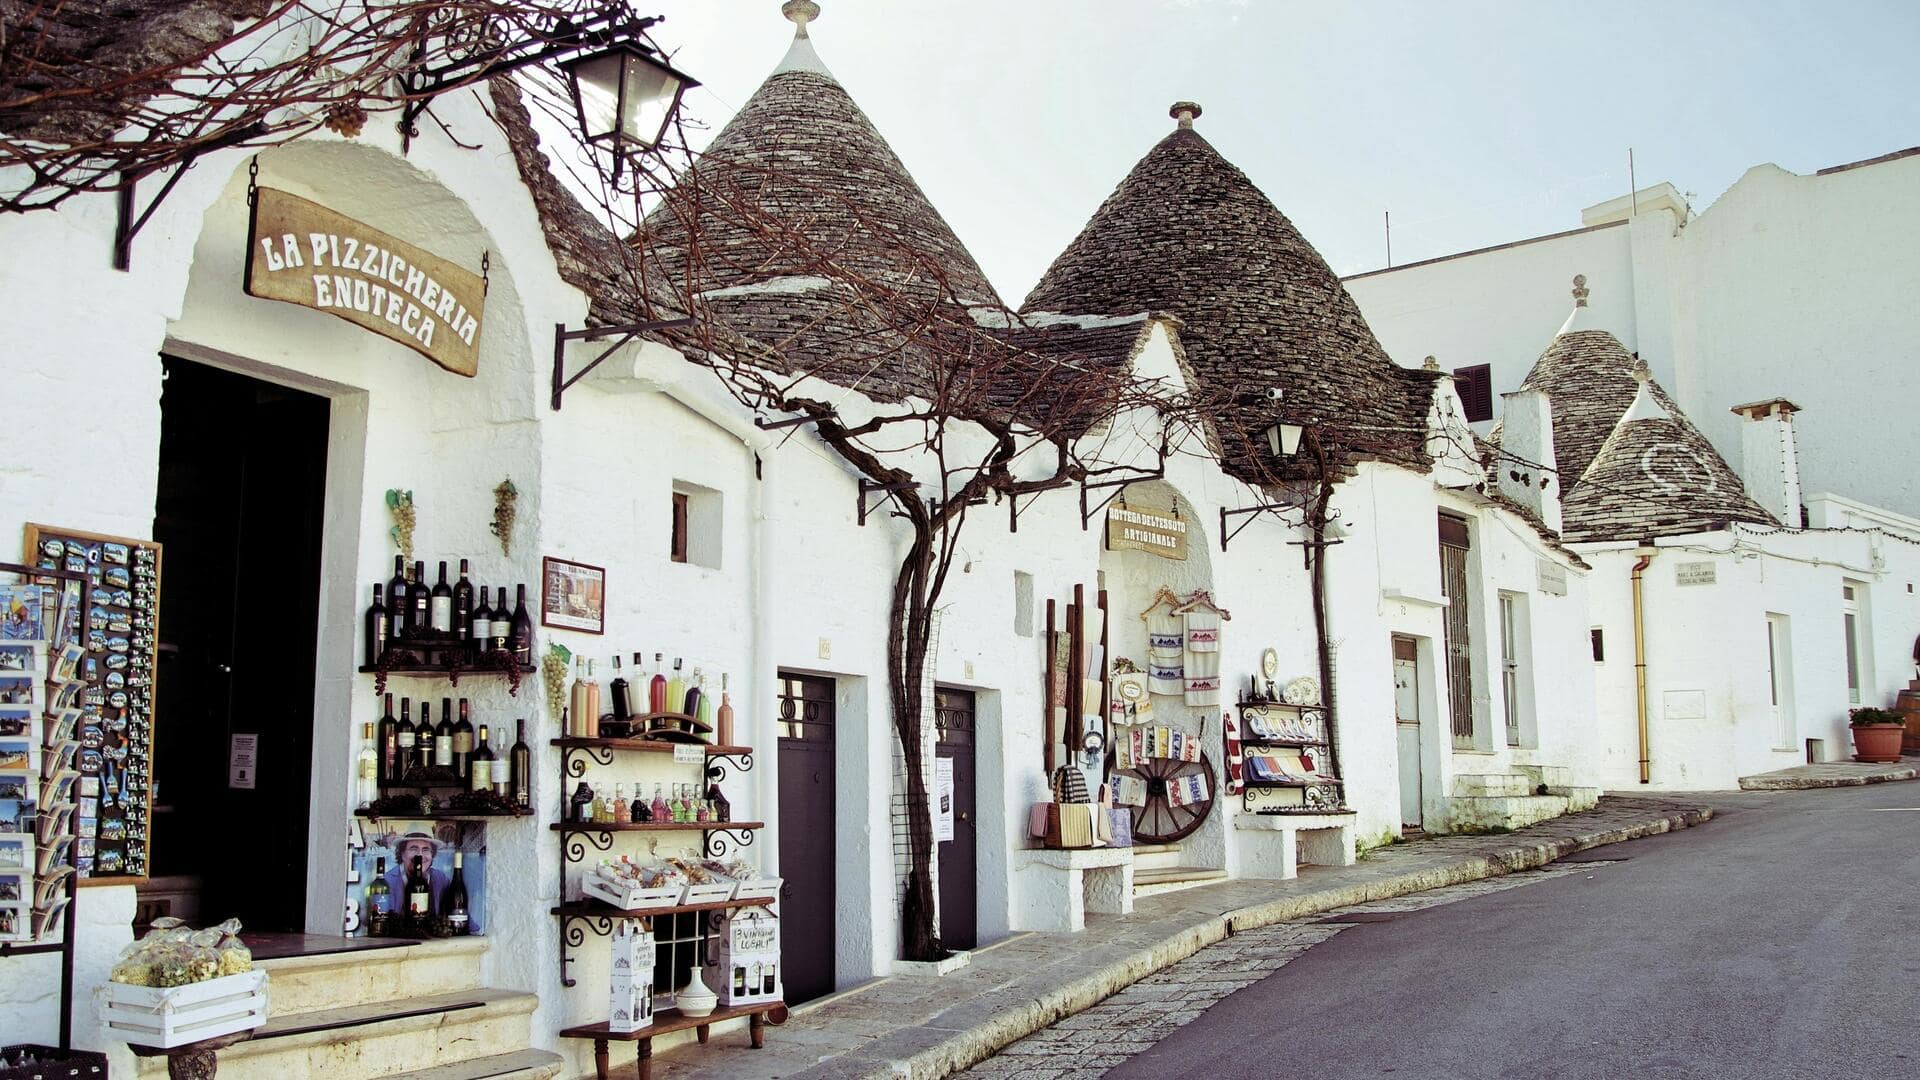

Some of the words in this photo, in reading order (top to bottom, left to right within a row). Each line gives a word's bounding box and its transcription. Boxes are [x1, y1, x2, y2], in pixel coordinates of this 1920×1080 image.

[261, 233, 304, 271] LA
[309, 233, 478, 346] PIZZICHERIA
[313, 275, 436, 348] ENOTECA
[1124, 528, 1176, 548] ARTIGIANALE
[1155, 516, 1186, 533] TESSUTO
